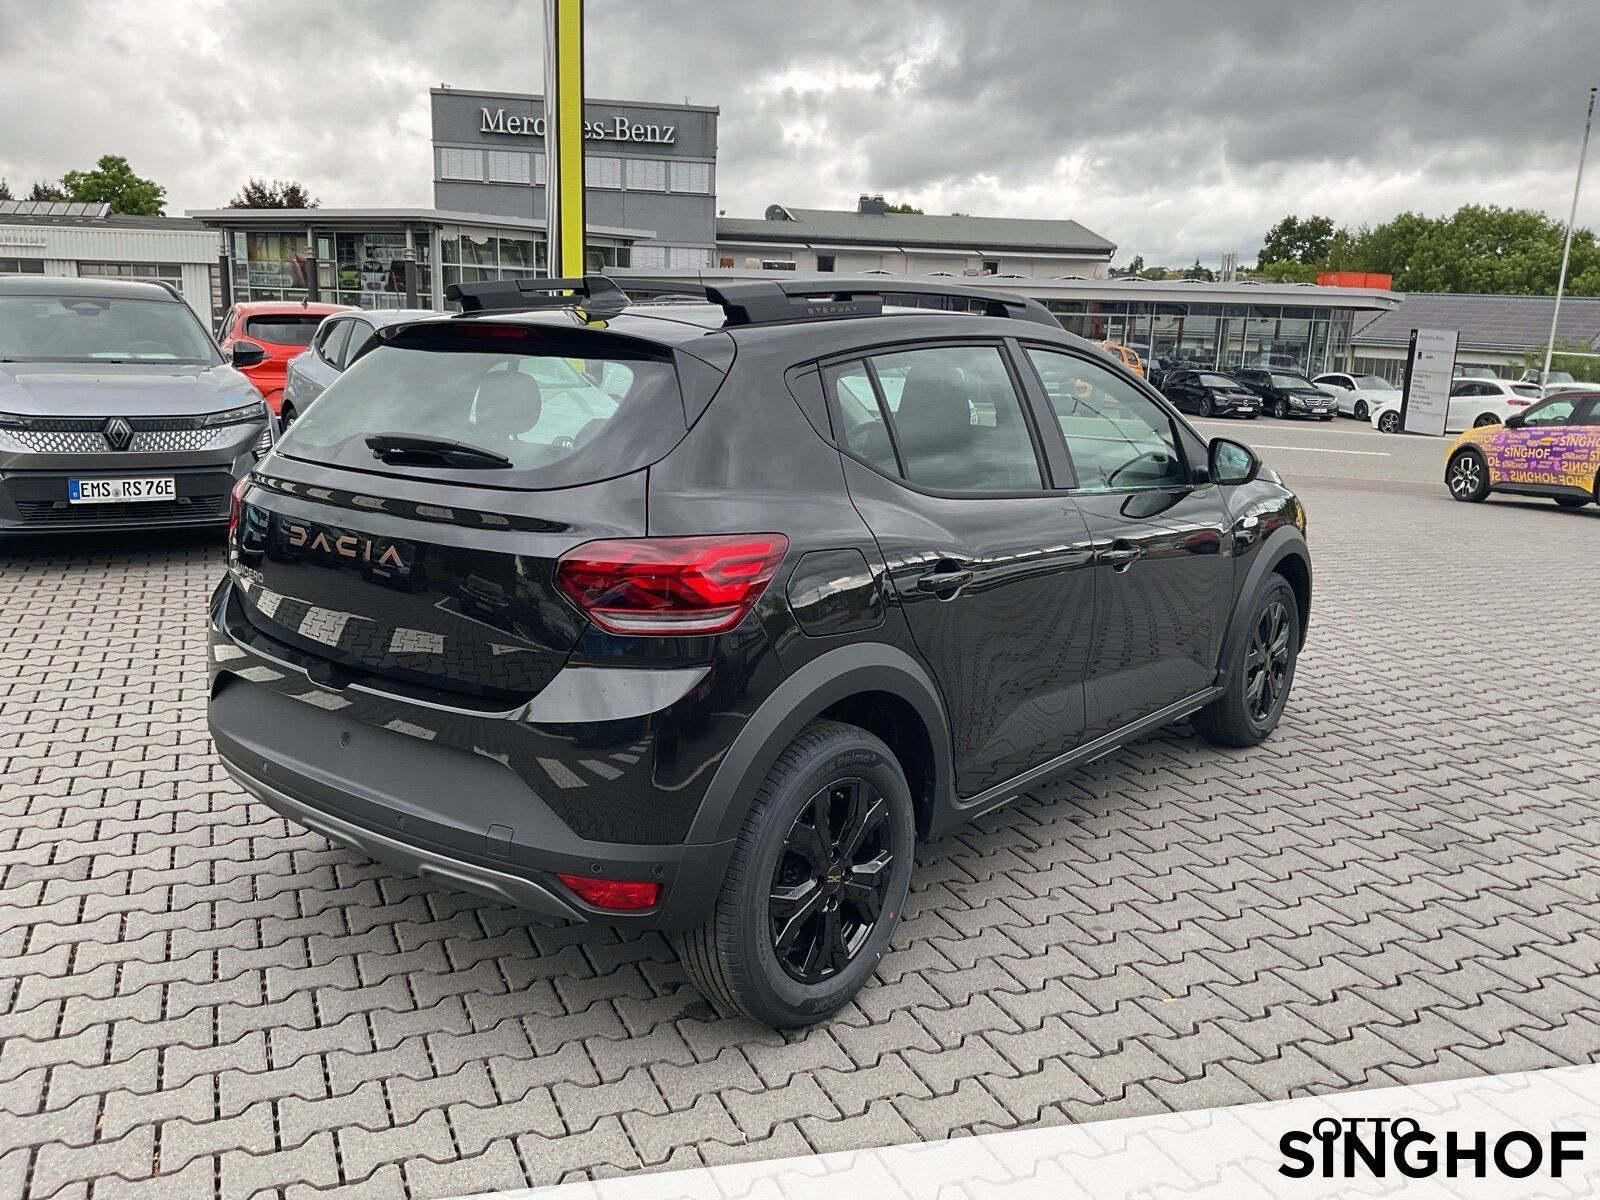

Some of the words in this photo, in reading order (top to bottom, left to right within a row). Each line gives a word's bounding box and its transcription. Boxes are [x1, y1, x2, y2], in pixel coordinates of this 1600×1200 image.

[480, 107, 675, 144] Merces-Benz
[1504, 447, 1550, 459] SINGHOF
[80, 482, 111, 498] EMS
[122, 481, 142, 497] RS
[145, 480, 174, 496] 76E
[289, 525, 404, 568] DACIA
